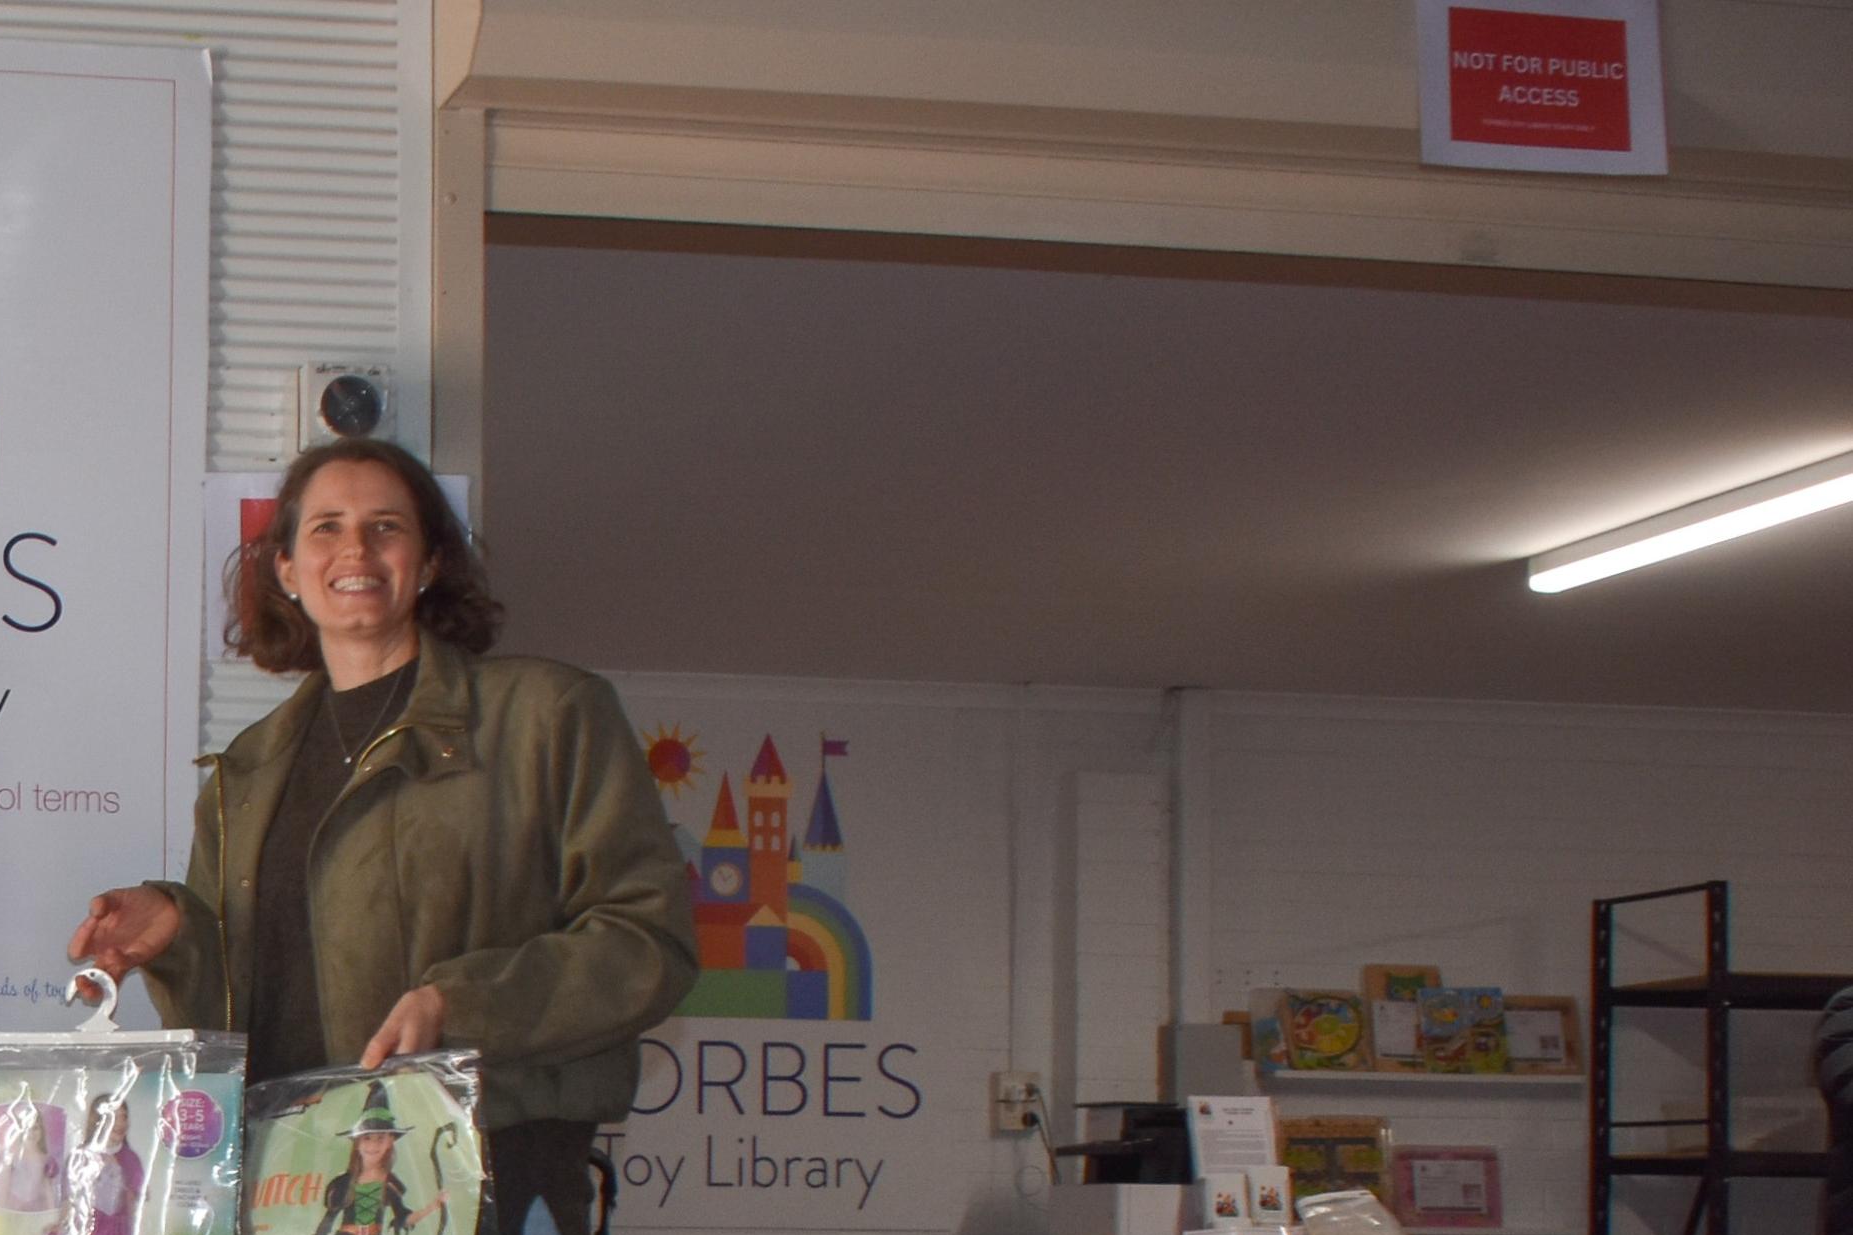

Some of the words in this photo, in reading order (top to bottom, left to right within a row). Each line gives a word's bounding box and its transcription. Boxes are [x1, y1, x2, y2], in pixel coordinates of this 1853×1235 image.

[1453, 51, 1496, 70] NOT
[1502, 55, 1543, 75] FOR
[1549, 59, 1625, 80] PUBLIC
[1498, 85, 1580, 107] ACCESS
[32, 784, 121, 814] terms
[23, 979, 39, 1004] of
[629, 1038, 923, 1120] ORBES
[706, 1134, 884, 1210] Library
